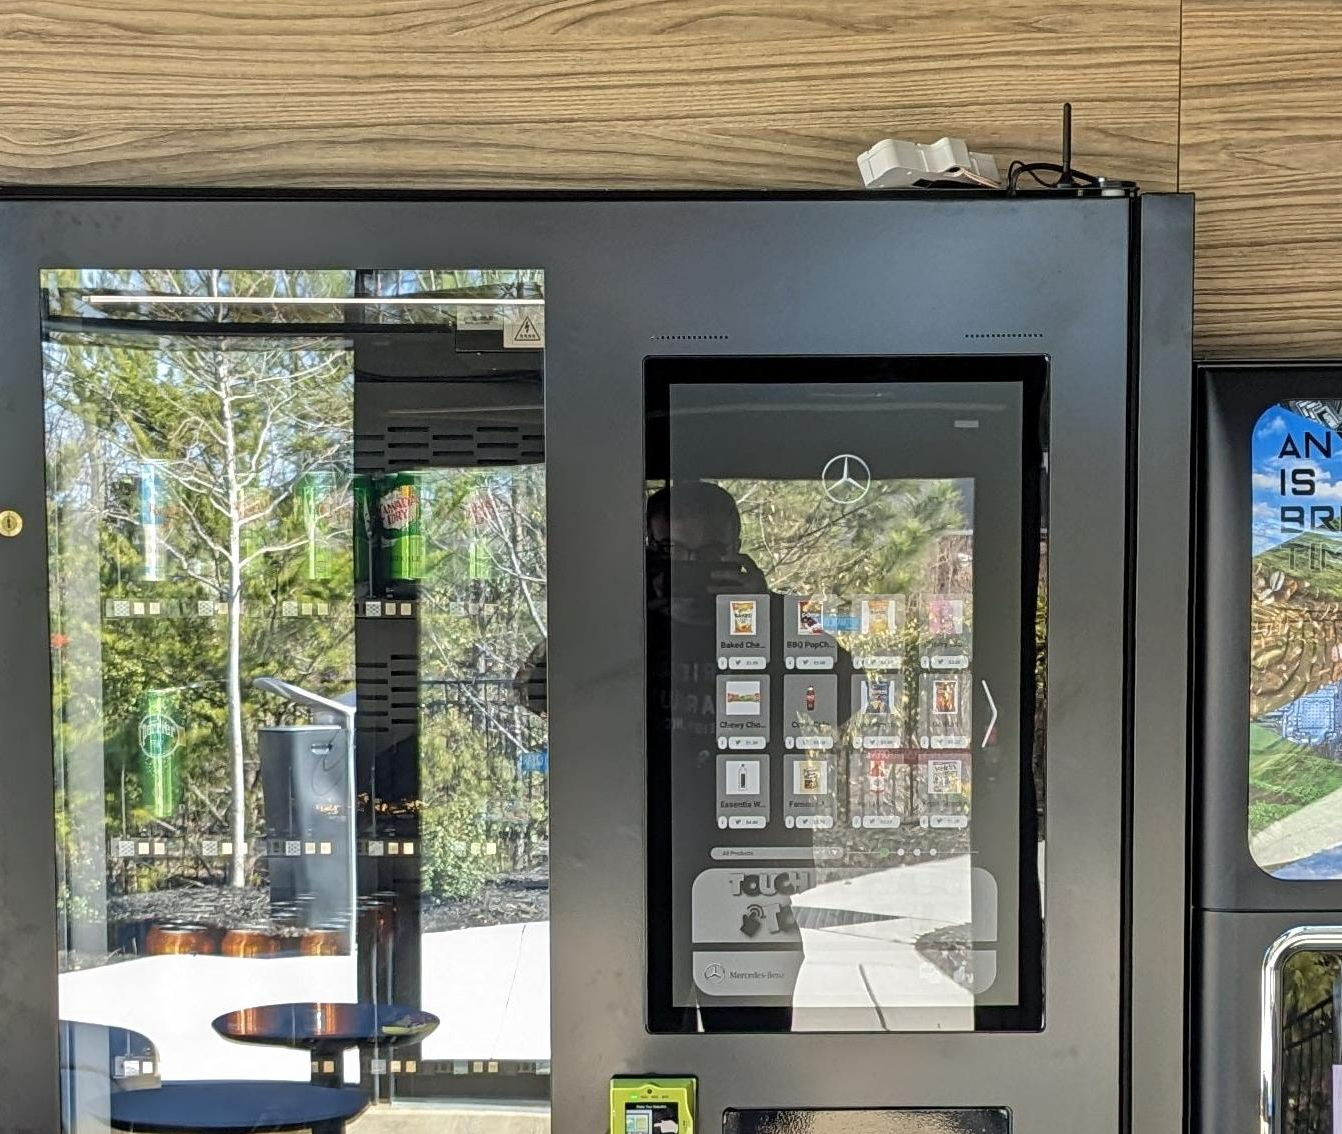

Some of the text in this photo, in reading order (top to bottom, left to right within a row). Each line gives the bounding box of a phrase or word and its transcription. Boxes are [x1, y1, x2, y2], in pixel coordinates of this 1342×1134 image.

[1279, 468, 1316, 496] IS
[729, 872, 809, 897] TOUCH
[730, 971, 784, 979] Mercedes-Benz
